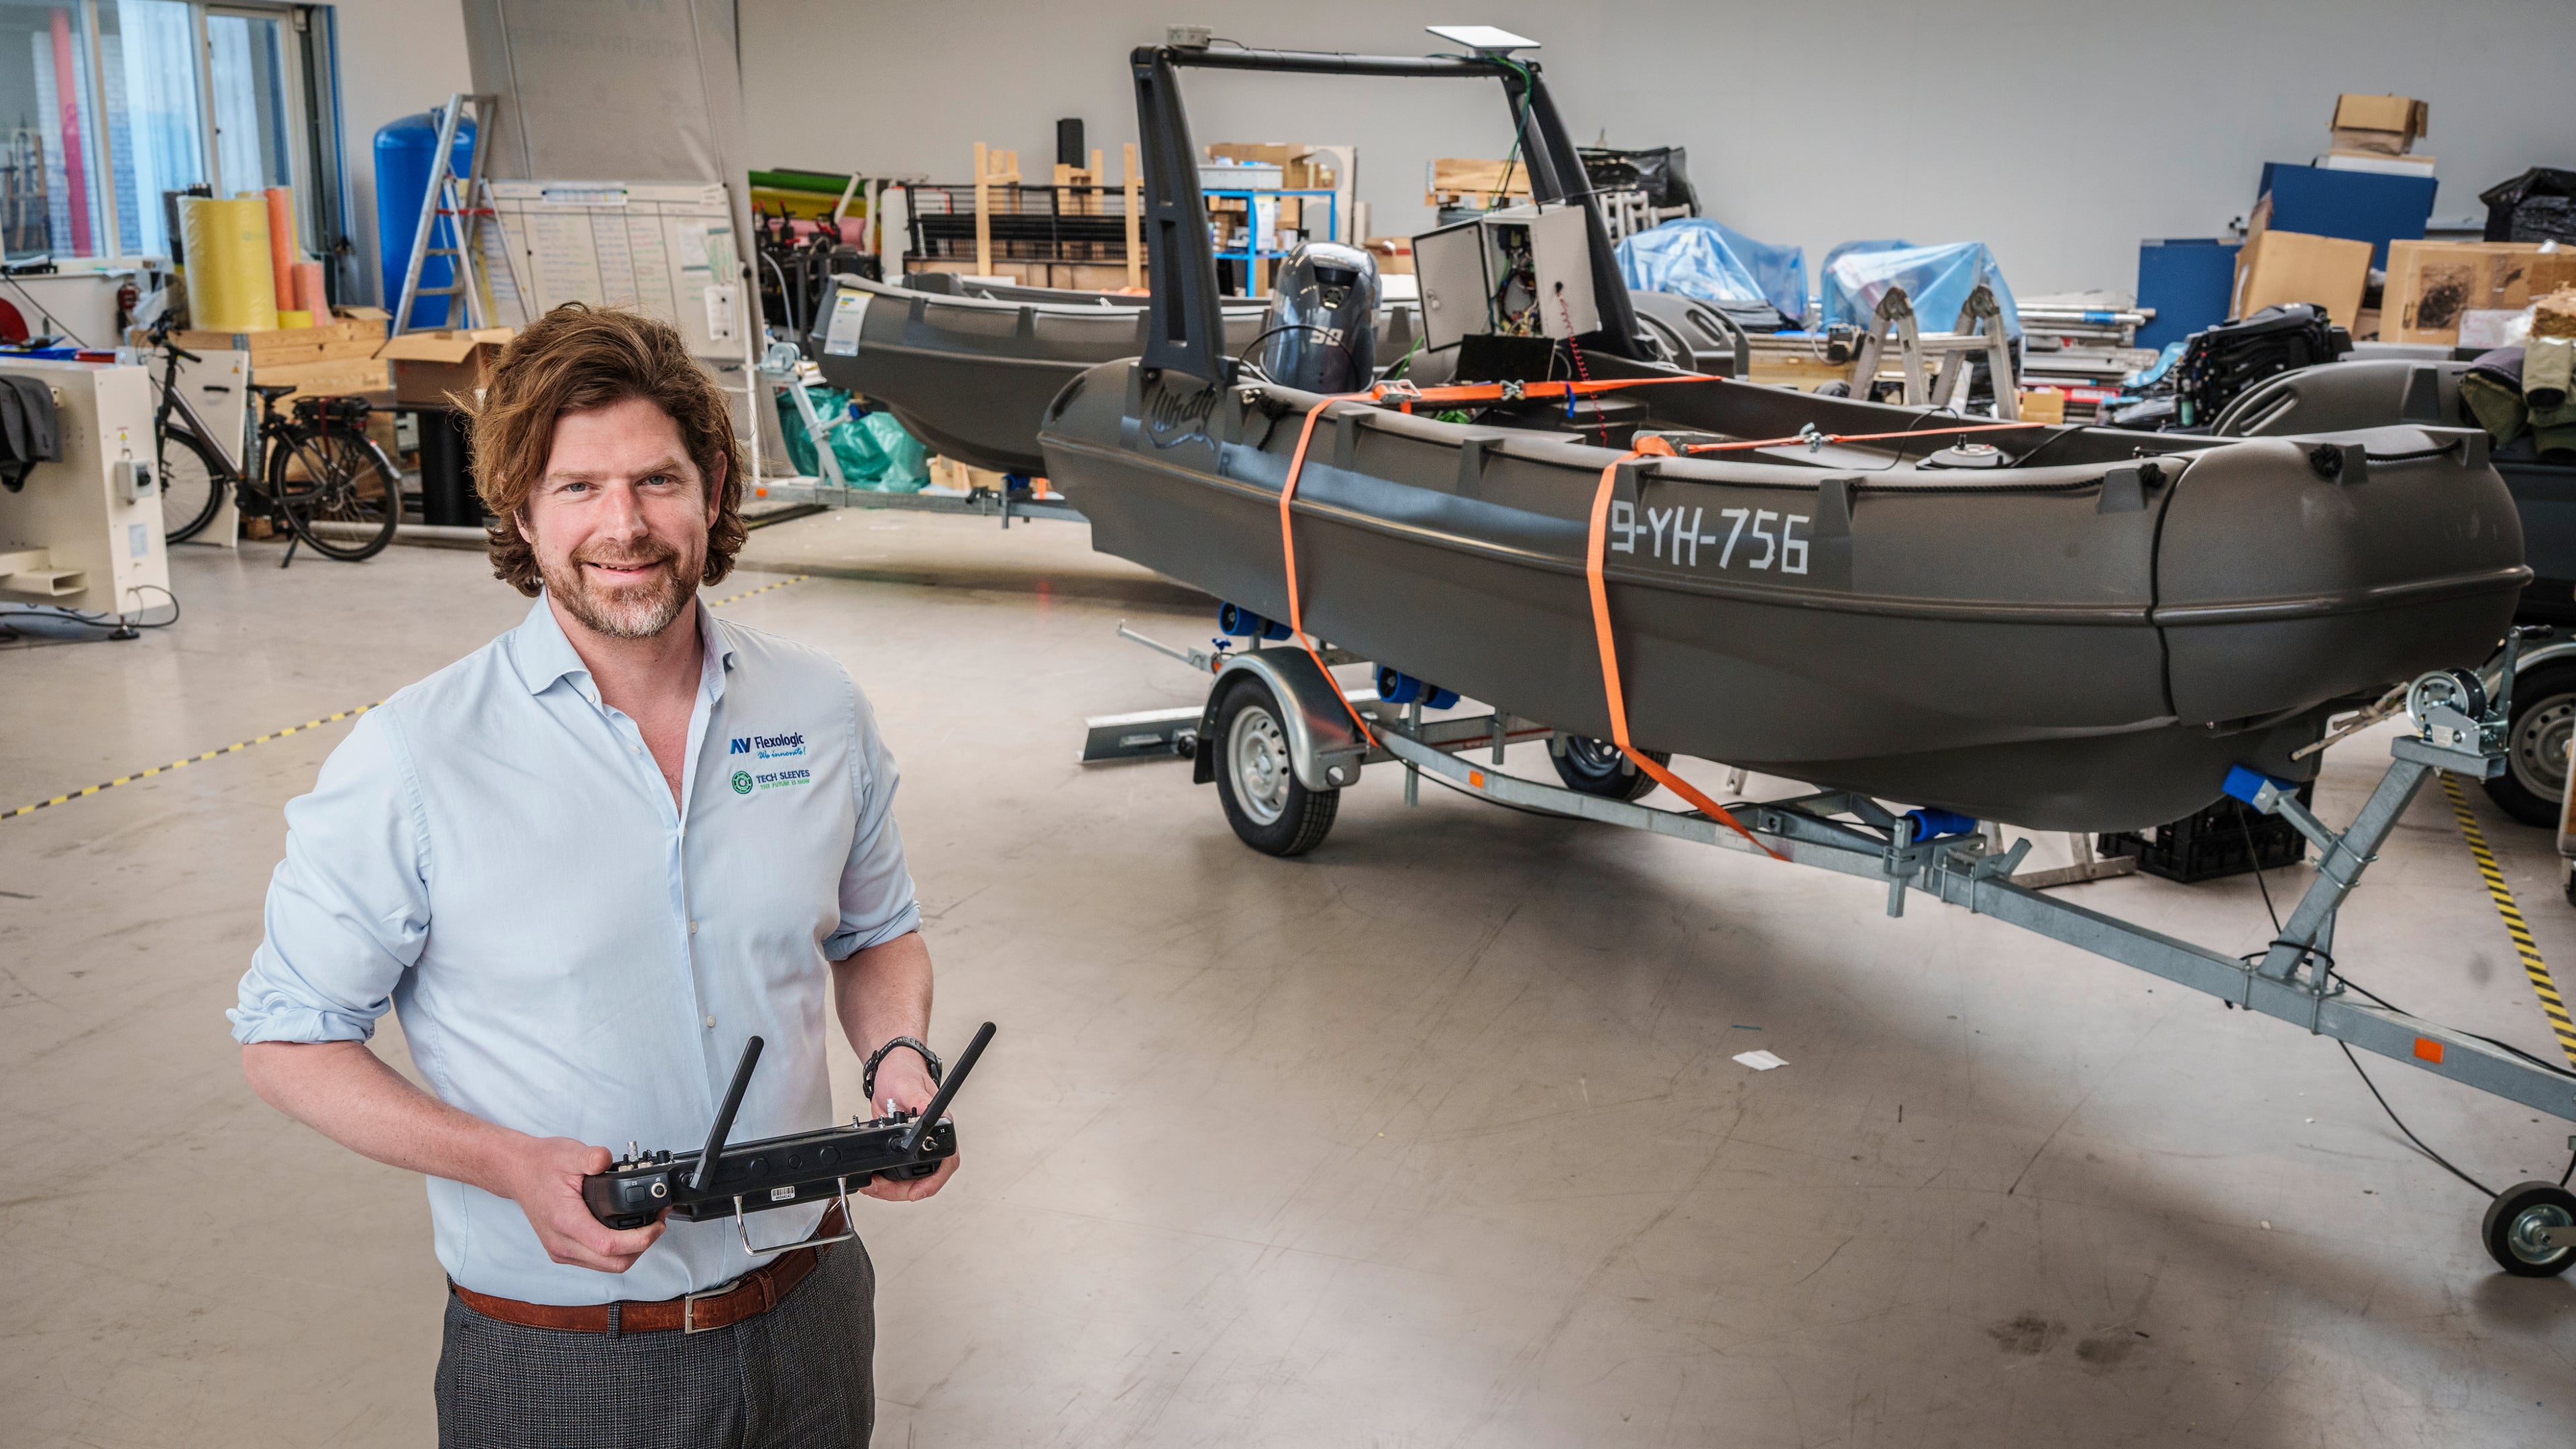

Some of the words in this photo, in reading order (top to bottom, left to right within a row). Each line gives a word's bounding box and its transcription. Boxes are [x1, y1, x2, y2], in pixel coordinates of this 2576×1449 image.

[1309, 325, 1344, 347] 50
[1611, 500, 1810, 575] 9-YH-756
[754, 732, 804, 749] Flexologic
[757, 750, 770, 759] We
[771, 746, 806, 757] innovate!
[756, 773, 777, 784] TECH
[780, 769, 810, 780] SLEEVES
[772, 780, 790, 788] FUTURE
